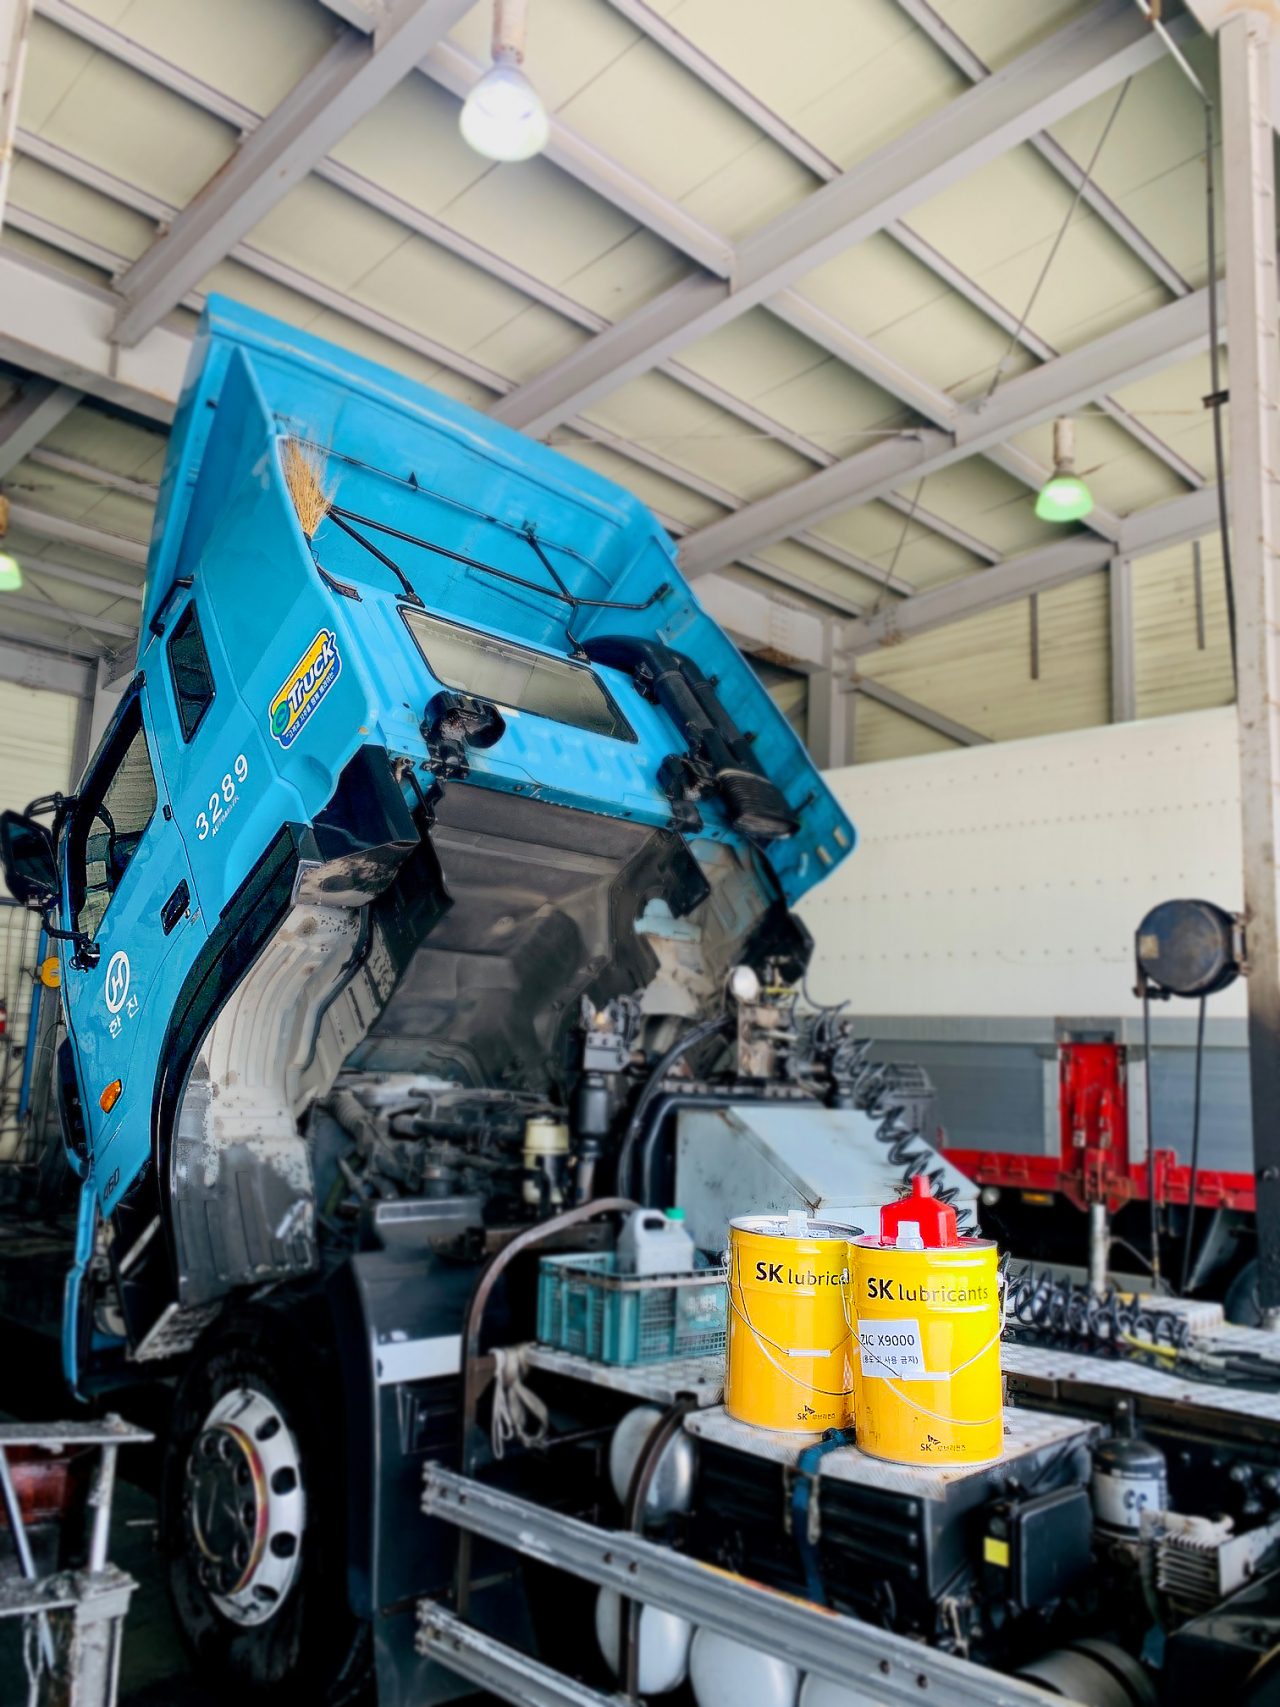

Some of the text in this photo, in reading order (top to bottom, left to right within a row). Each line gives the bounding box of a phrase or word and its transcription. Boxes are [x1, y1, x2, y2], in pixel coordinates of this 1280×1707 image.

[195, 754, 248, 840] 3289
[755, 1261, 784, 1283] SK
[867, 1277, 988, 1302] SK lubricants
[860, 1333, 915, 1346] ZIC X9000
[884, 1355, 898, 1365] 사용
[900, 1355, 919, 1365] 금지)
[797, 1411, 808, 1421] SK
[920, 1442, 932, 1452] SK
